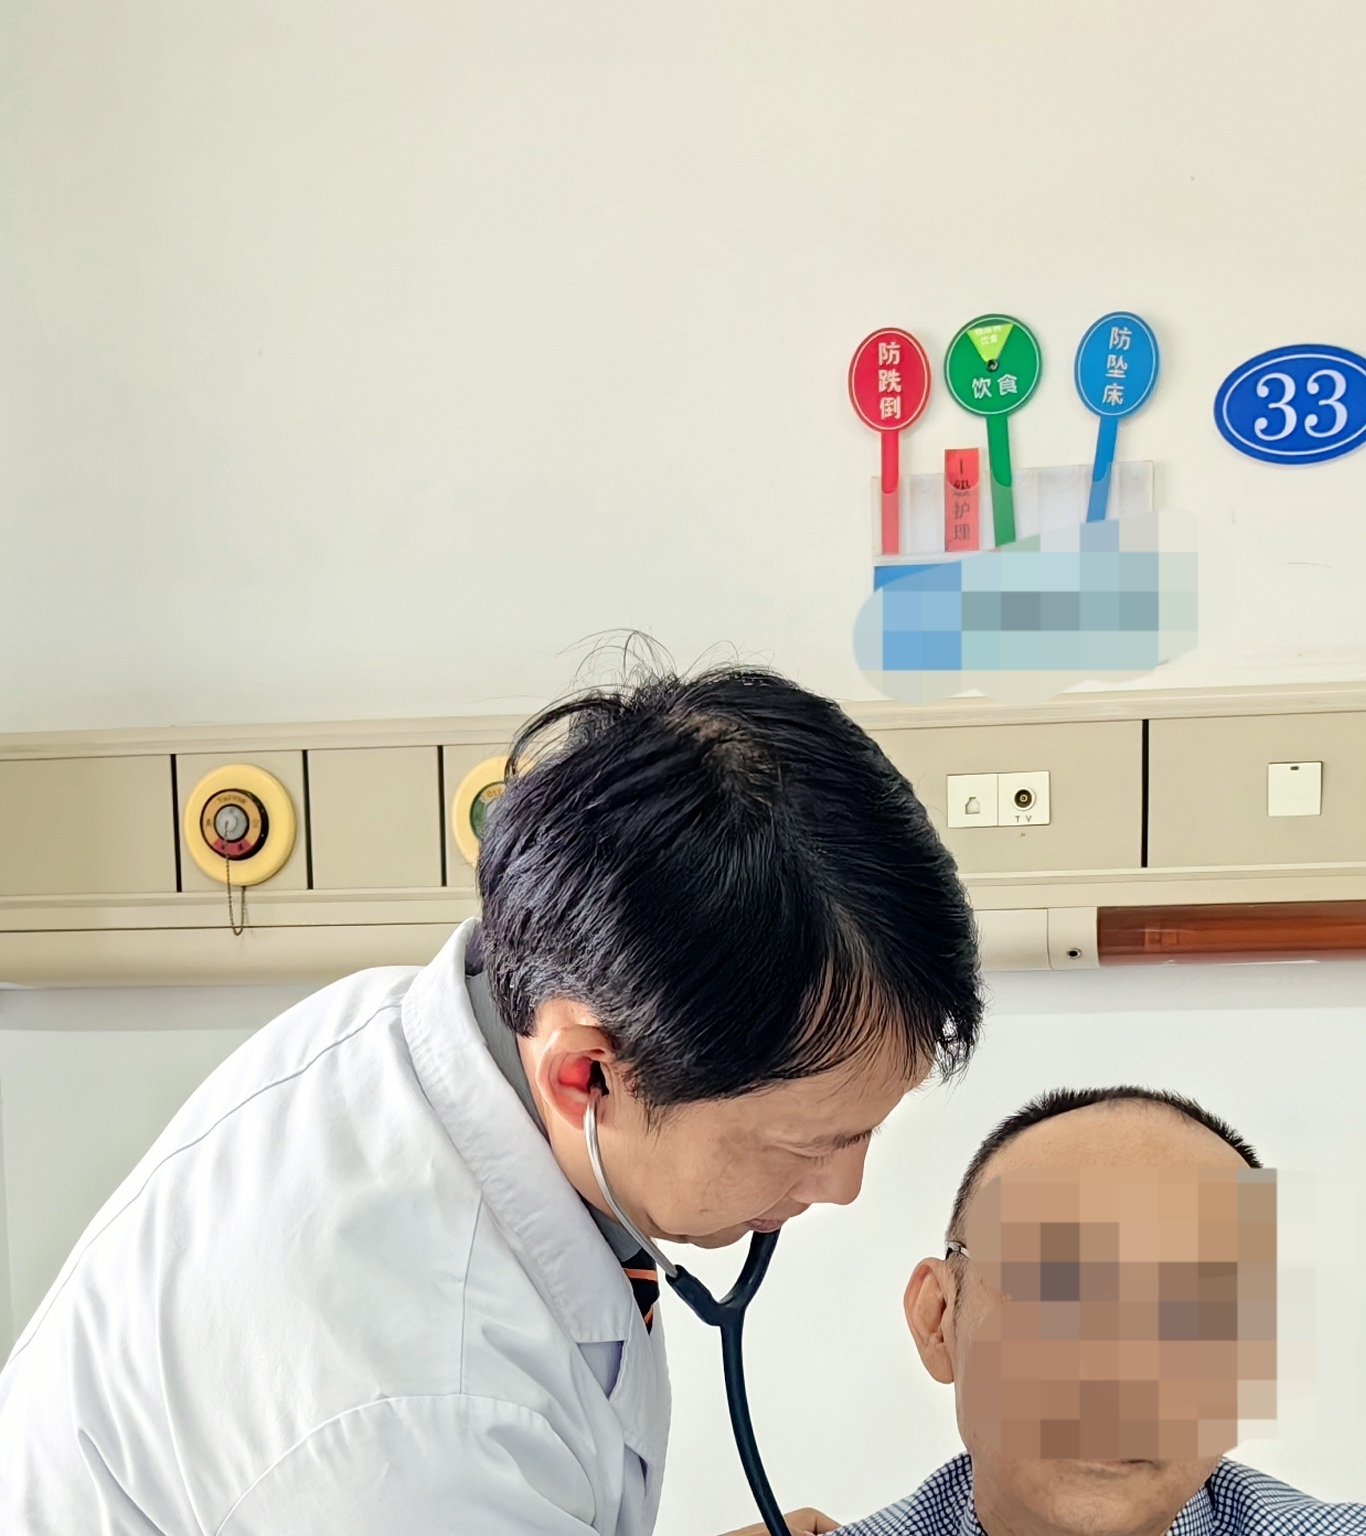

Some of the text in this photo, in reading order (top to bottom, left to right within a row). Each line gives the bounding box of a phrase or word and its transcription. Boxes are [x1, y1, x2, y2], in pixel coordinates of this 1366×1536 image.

[877, 341, 902, 421] 防跌倒
[971, 373, 1019, 401] 饮食
[1101, 326, 1133, 406] 防坠床
[1254, 369, 1348, 441] 33
